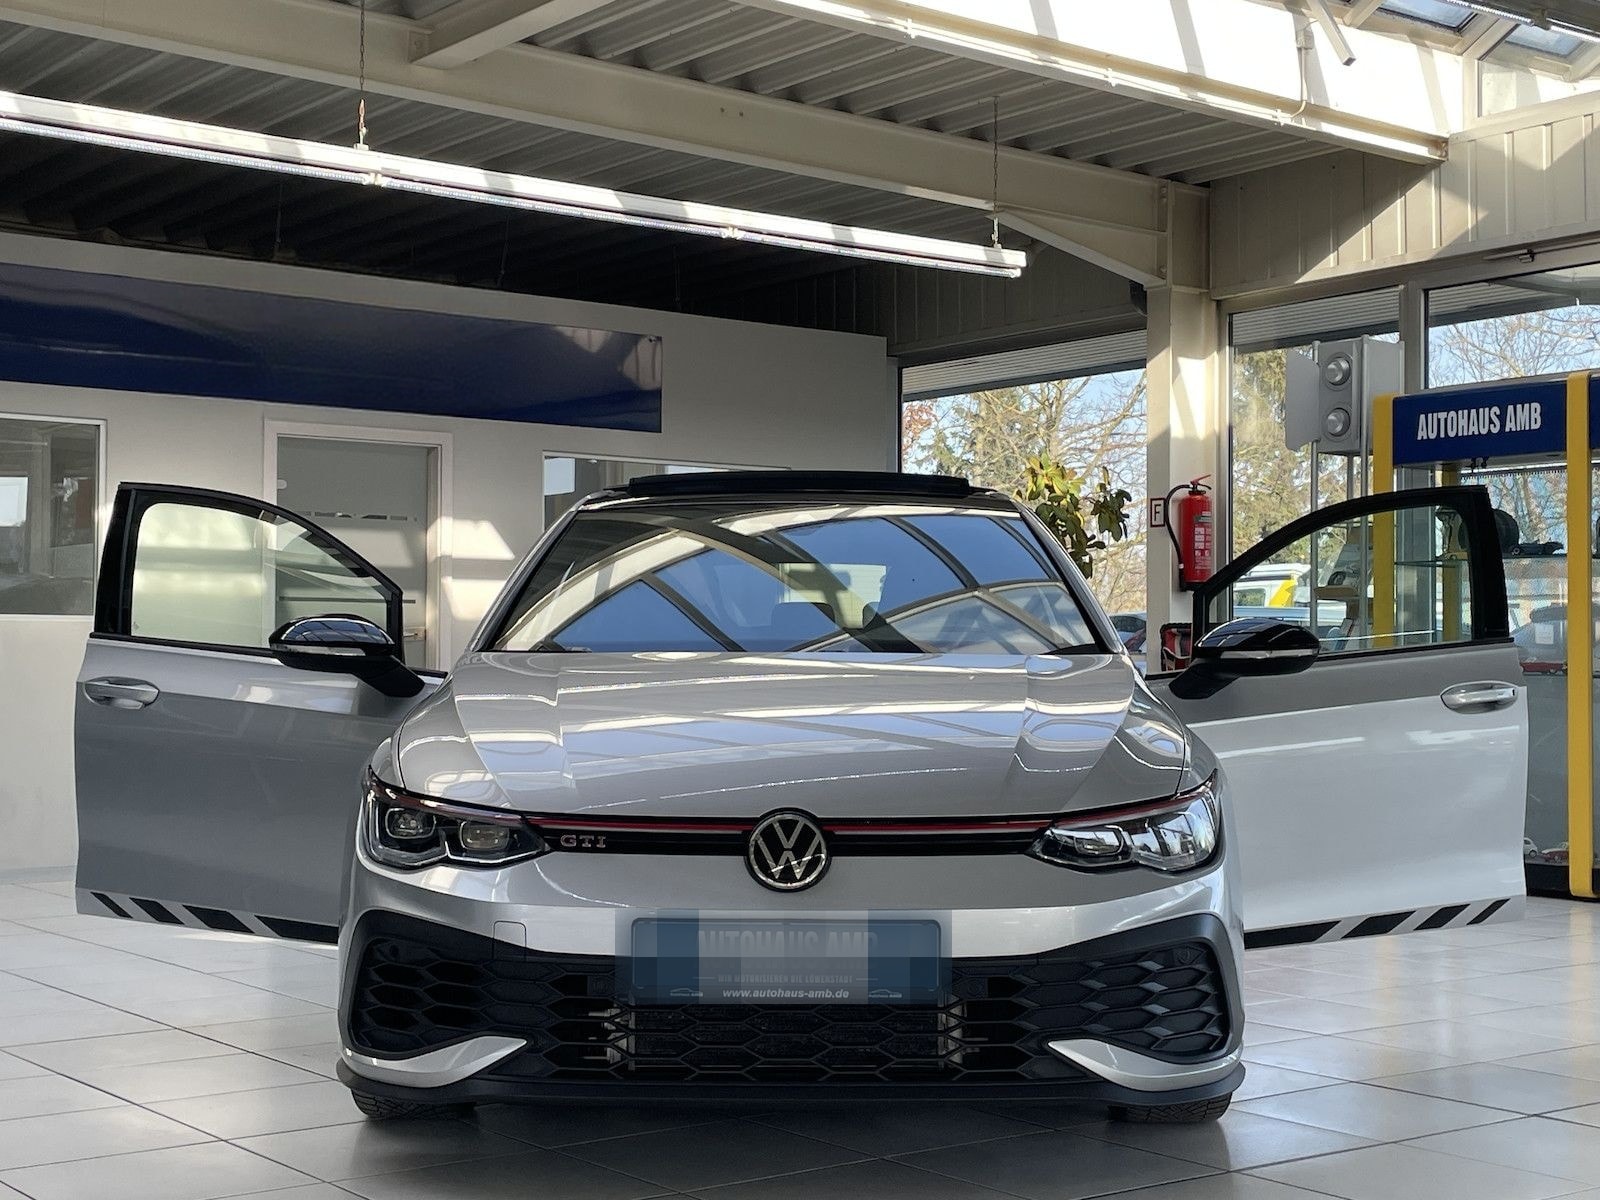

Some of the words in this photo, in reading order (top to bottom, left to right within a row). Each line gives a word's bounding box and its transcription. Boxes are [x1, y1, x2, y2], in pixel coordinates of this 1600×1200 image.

[1417, 406, 1500, 440] AUTOHAUS
[1505, 402, 1542, 432] AMB
[1154, 503, 1162, 521] F
[560, 834, 606, 848] GTI
[697, 930, 819, 969] AUTOHAUS
[826, 931, 878, 969] AMB
[722, 988, 850, 999] www.autohaus-amb.de
